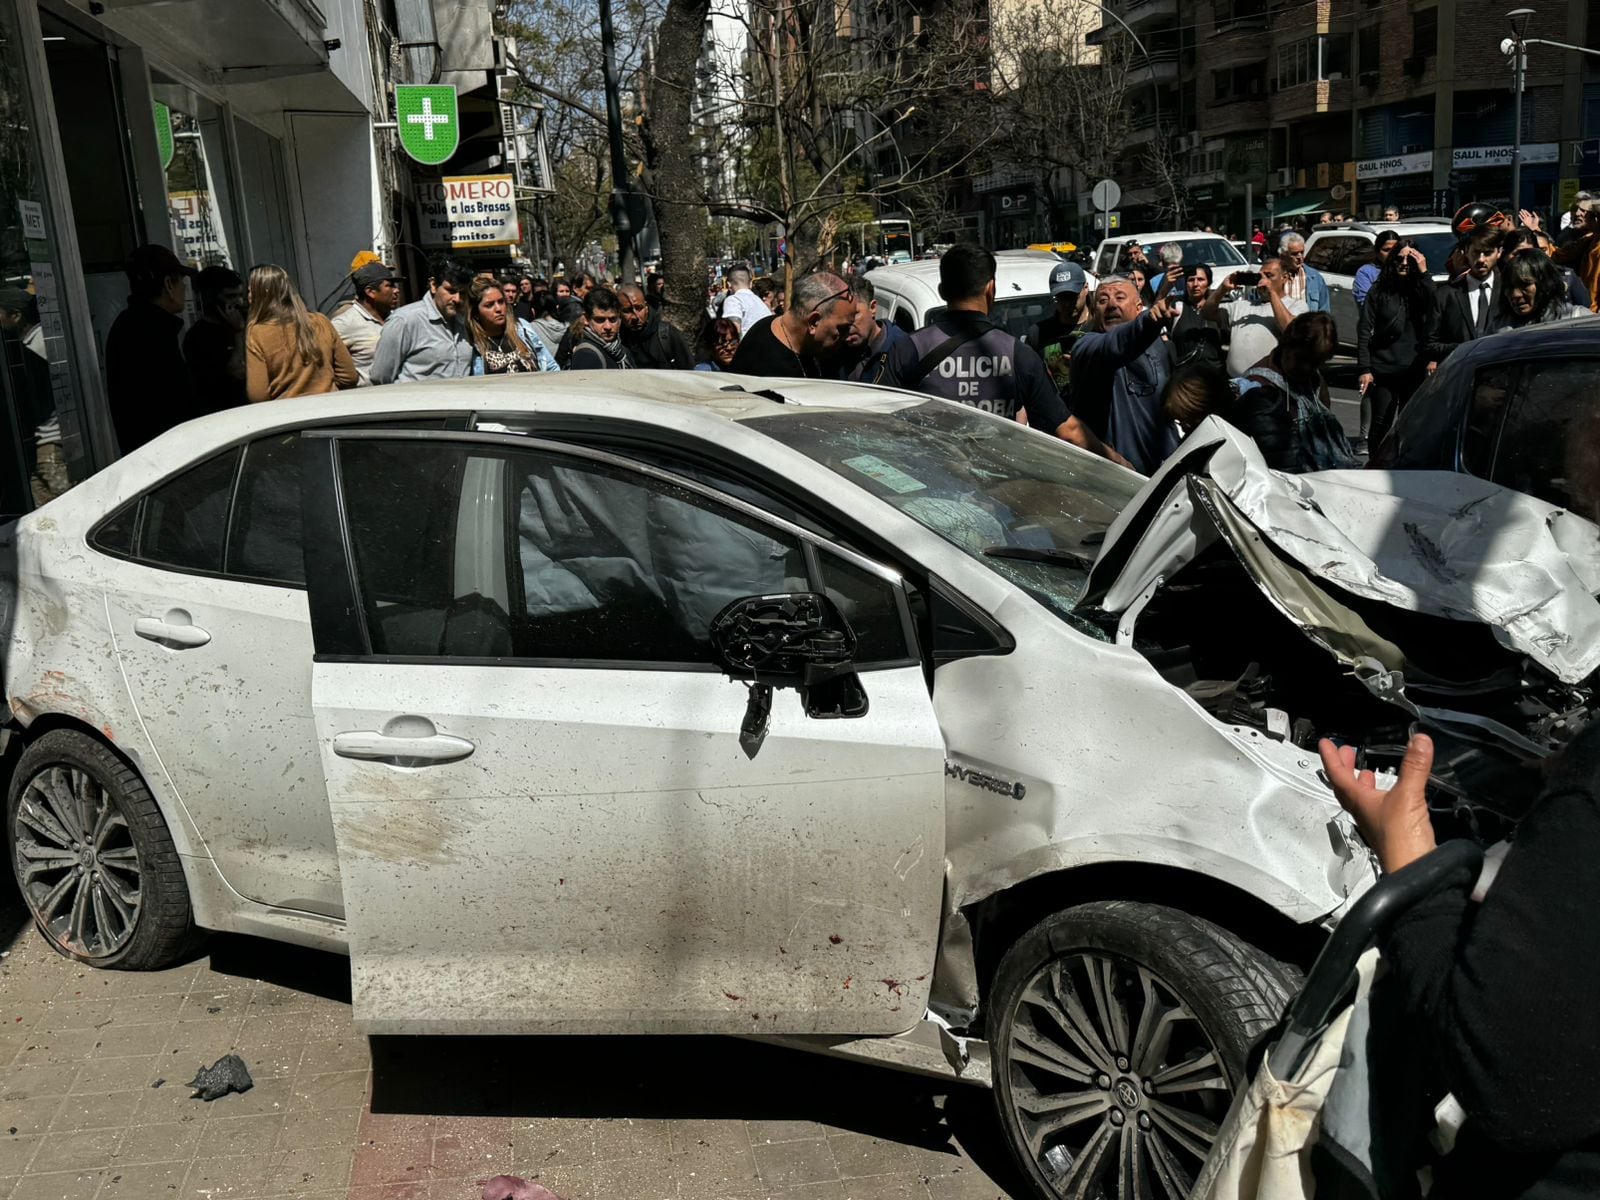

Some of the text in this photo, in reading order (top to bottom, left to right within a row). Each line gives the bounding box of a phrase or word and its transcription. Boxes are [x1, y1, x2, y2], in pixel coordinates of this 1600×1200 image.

[1454, 150, 1482, 160] SAUL
[1358, 162, 1378, 172] SAUL
[417, 181, 510, 202] HOMERO
[422, 202, 447, 215] Pollo
[460, 202, 475, 213] las
[477, 202, 511, 212] Brasas
[430, 216, 505, 230] Empanadas
[443, 232, 495, 241] Lomitos
[925, 355, 1013, 378] OLICIA
[958, 381, 979, 396] DE
